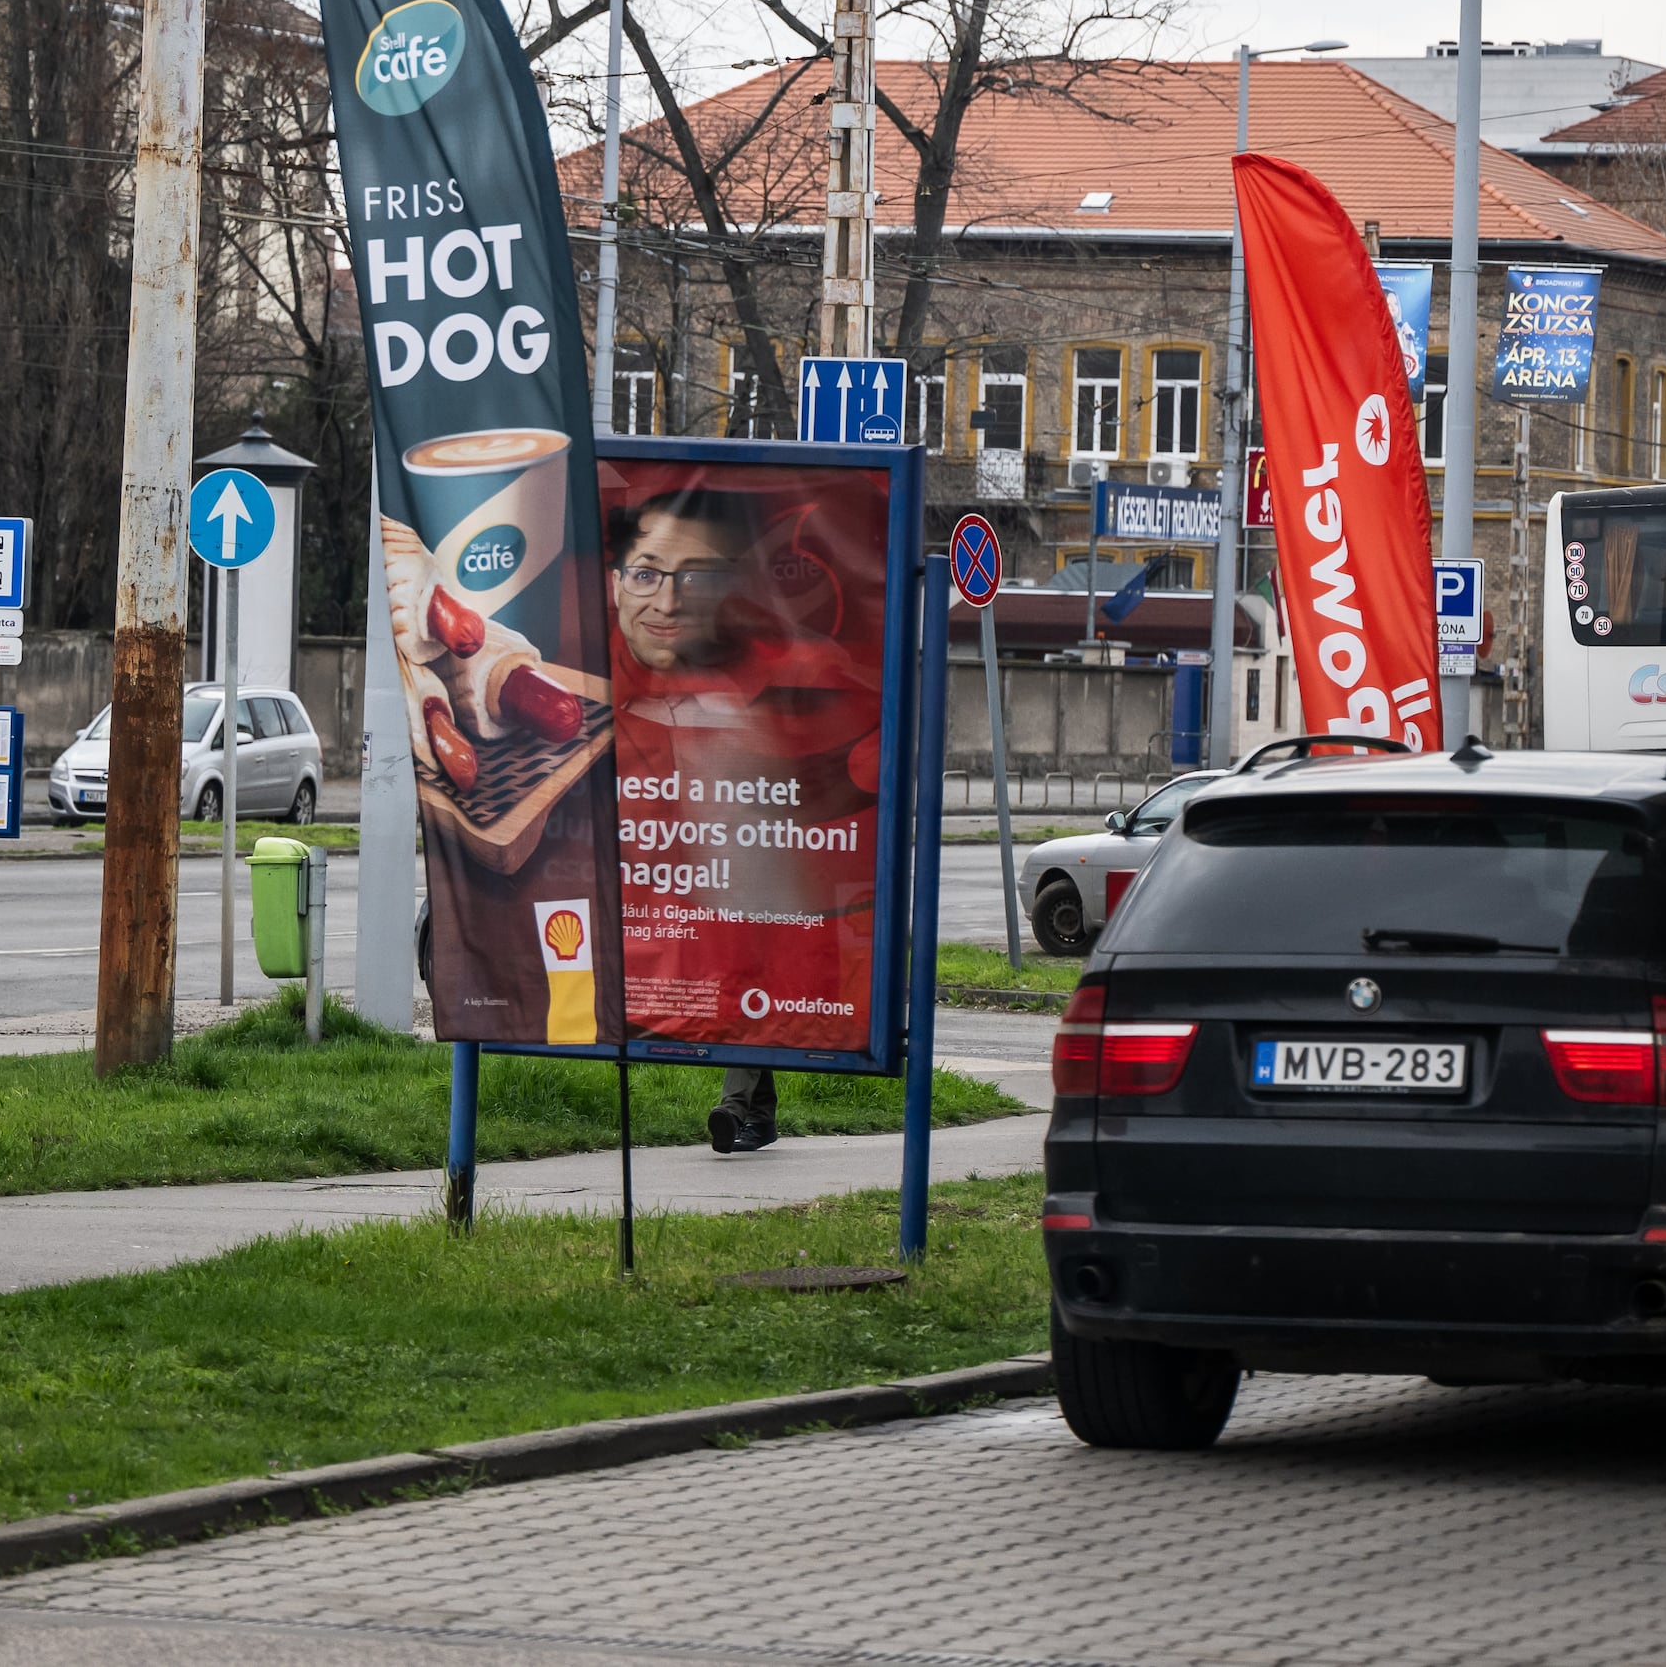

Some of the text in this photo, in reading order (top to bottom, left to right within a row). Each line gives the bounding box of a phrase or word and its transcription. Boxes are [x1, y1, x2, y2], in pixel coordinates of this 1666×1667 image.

[374, 35, 448, 83] café
[364, 178, 465, 221] FRISS
[367, 223, 523, 305] HOT
[1507, 292, 1594, 315] KONCZ
[1503, 313, 1594, 336] ZSUZSA
[373, 304, 550, 389] DOG
[1505, 340, 1581, 367] ÁPR. 13.
[1501, 364, 1577, 388] ARÉNA
[1117, 488, 1171, 536] KÉSZENLÉTI
[464, 543, 514, 572] café
[1569, 548, 1582, 557] 100
[1570, 567, 1581, 576] 90
[1572, 584, 1584, 595] 70
[1581, 611, 1589, 619] 70
[1598, 621, 1608, 630] 50
[617, 770, 801, 807] esd a netet
[736, 819, 858, 852] otthoni
[652, 908, 661, 919] a
[664, 904, 716, 922] Gigabit
[718, 907, 744, 923] Net
[748, 909, 825, 930] sebességet
[654, 924, 700, 940] áráért.
[774, 997, 855, 1016] vodafone
[1259, 1066, 1270, 1078] H
[1284, 1047, 1456, 1083] MVB-283
